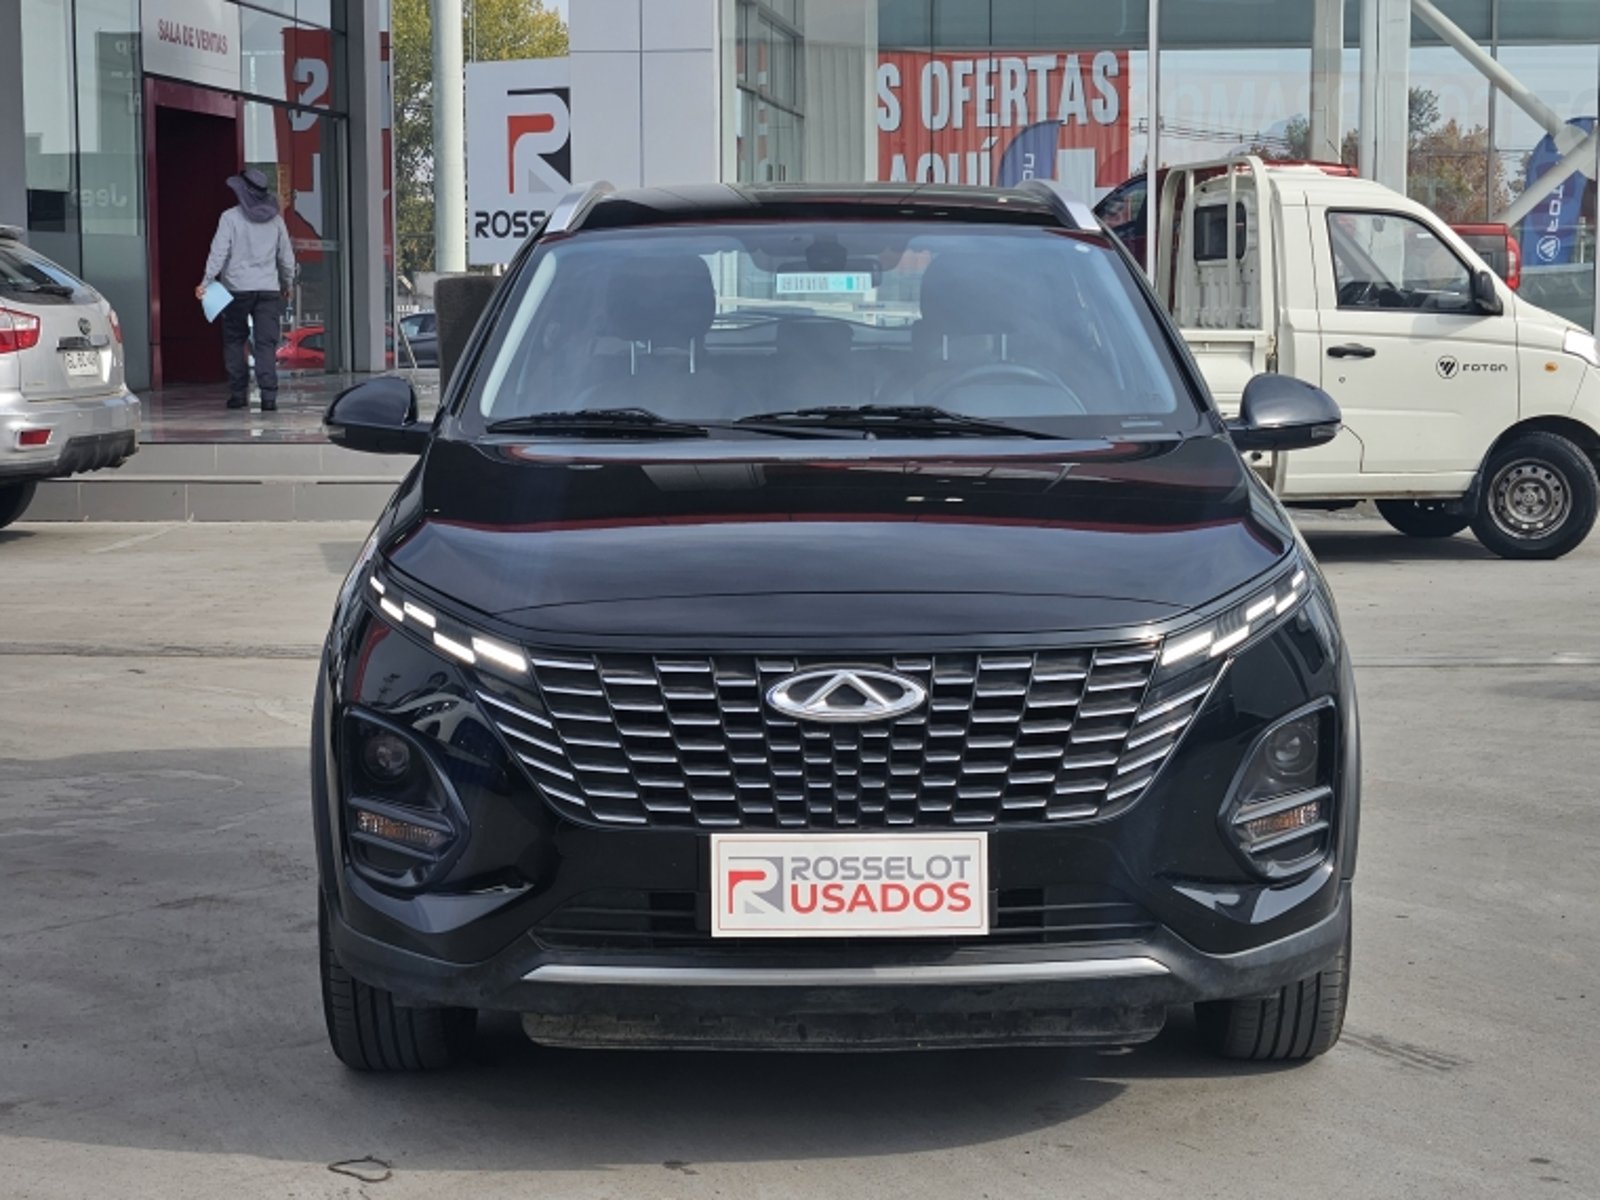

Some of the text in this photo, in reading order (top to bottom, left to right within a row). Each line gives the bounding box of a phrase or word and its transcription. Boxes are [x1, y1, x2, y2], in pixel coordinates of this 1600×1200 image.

[157, 17, 229, 56] SALA DE VENTAS
[920, 50, 1120, 132] OFERTAS
[1462, 363, 1509, 372] FOTON
[790, 854, 972, 881] ROSSELOT
[790, 882, 972, 914] USADOS
